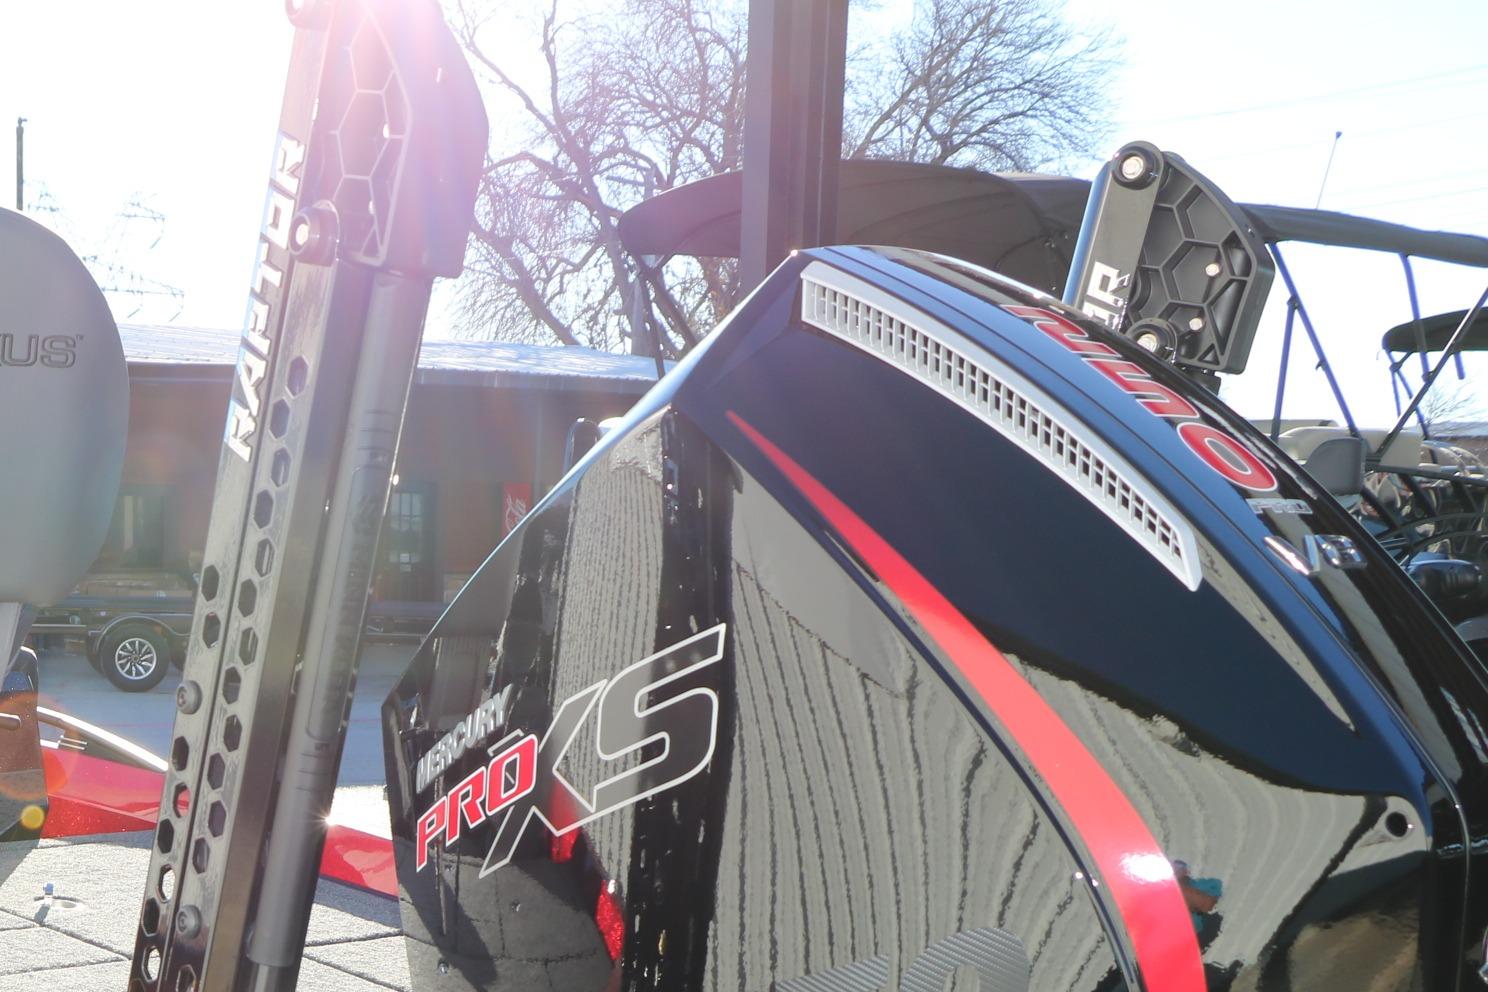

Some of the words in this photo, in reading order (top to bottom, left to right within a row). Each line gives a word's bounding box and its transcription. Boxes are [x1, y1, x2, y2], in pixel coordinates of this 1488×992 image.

[224, 131, 305, 462] RAPTOR
[416, 683, 513, 794] MERCURY
[416, 734, 538, 873] PRO
[478, 622, 726, 879] XS
